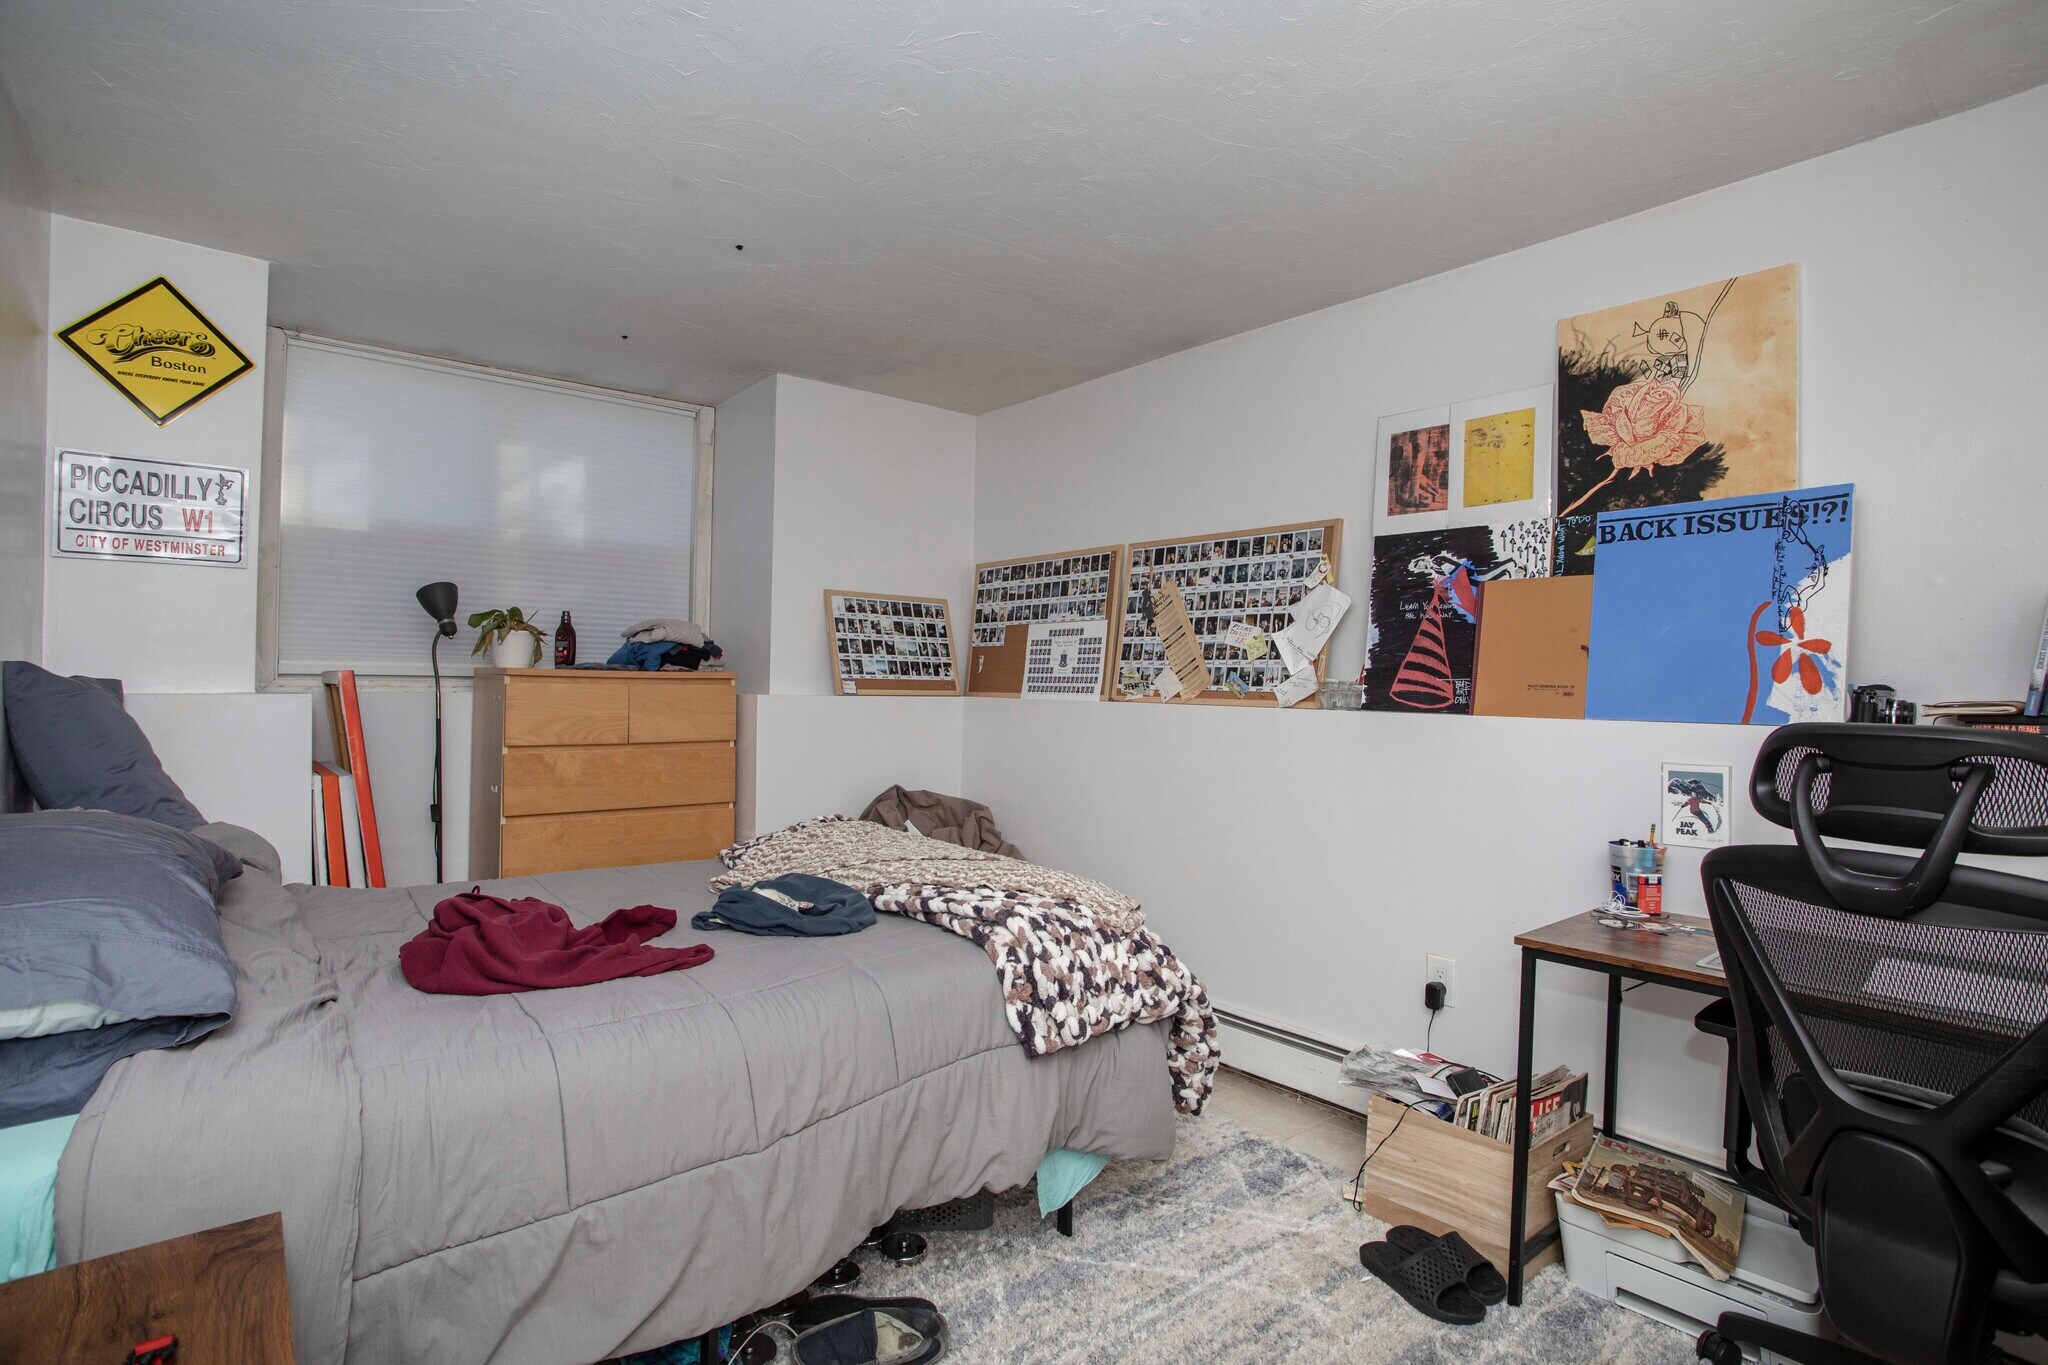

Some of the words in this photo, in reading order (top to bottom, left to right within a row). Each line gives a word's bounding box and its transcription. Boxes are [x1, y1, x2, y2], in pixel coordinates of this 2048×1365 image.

[86, 323, 216, 363] Cheers
[151, 356, 207, 374] Boston
[70, 463, 213, 502] PICCADILLY
[69, 498, 163, 530] CIRCUS
[182, 507, 214, 533] W1
[1598, 518, 1677, 545] BACK
[75, 534, 107, 549] CITY
[112, 537, 129, 551] OF
[134, 539, 225, 557] WESTMINSTER
[1676, 828, 1698, 836] PEAK
[1680, 821, 1695, 829] JAY
[1530, 1096, 1561, 1120] LIFE
